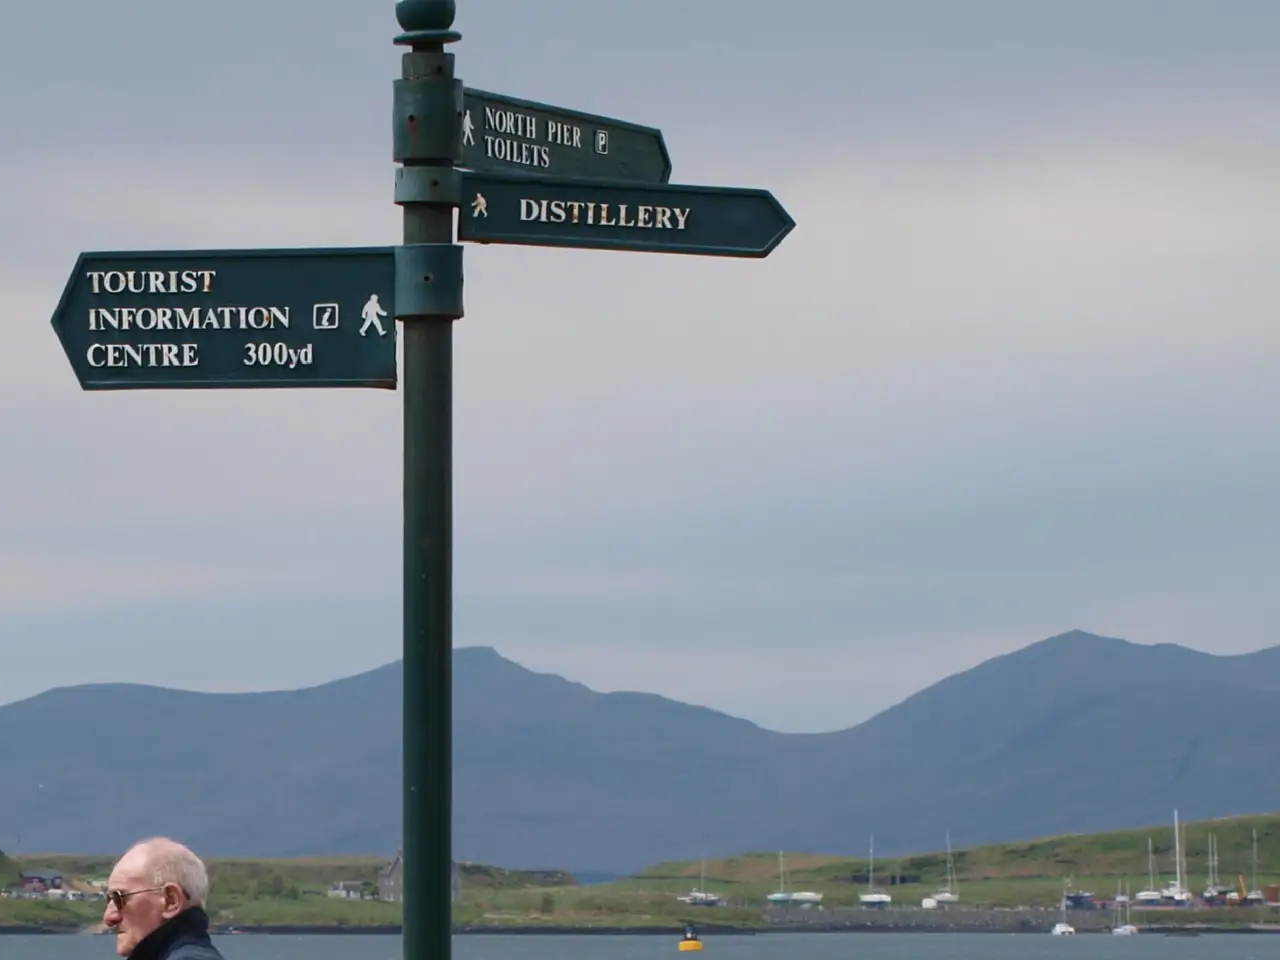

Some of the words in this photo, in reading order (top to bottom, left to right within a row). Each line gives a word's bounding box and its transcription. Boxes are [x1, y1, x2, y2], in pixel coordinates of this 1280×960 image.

[485, 107, 536, 140] NORTH
[547, 120, 581, 148] PIER
[485, 135, 549, 168] TOILETS
[519, 198, 690, 230] DISTILLERY
[87, 270, 216, 294] TOURIST
[88, 306, 290, 331] INFORMATION
[87, 343, 199, 368] CENTRE
[243, 342, 313, 369] 300yd
